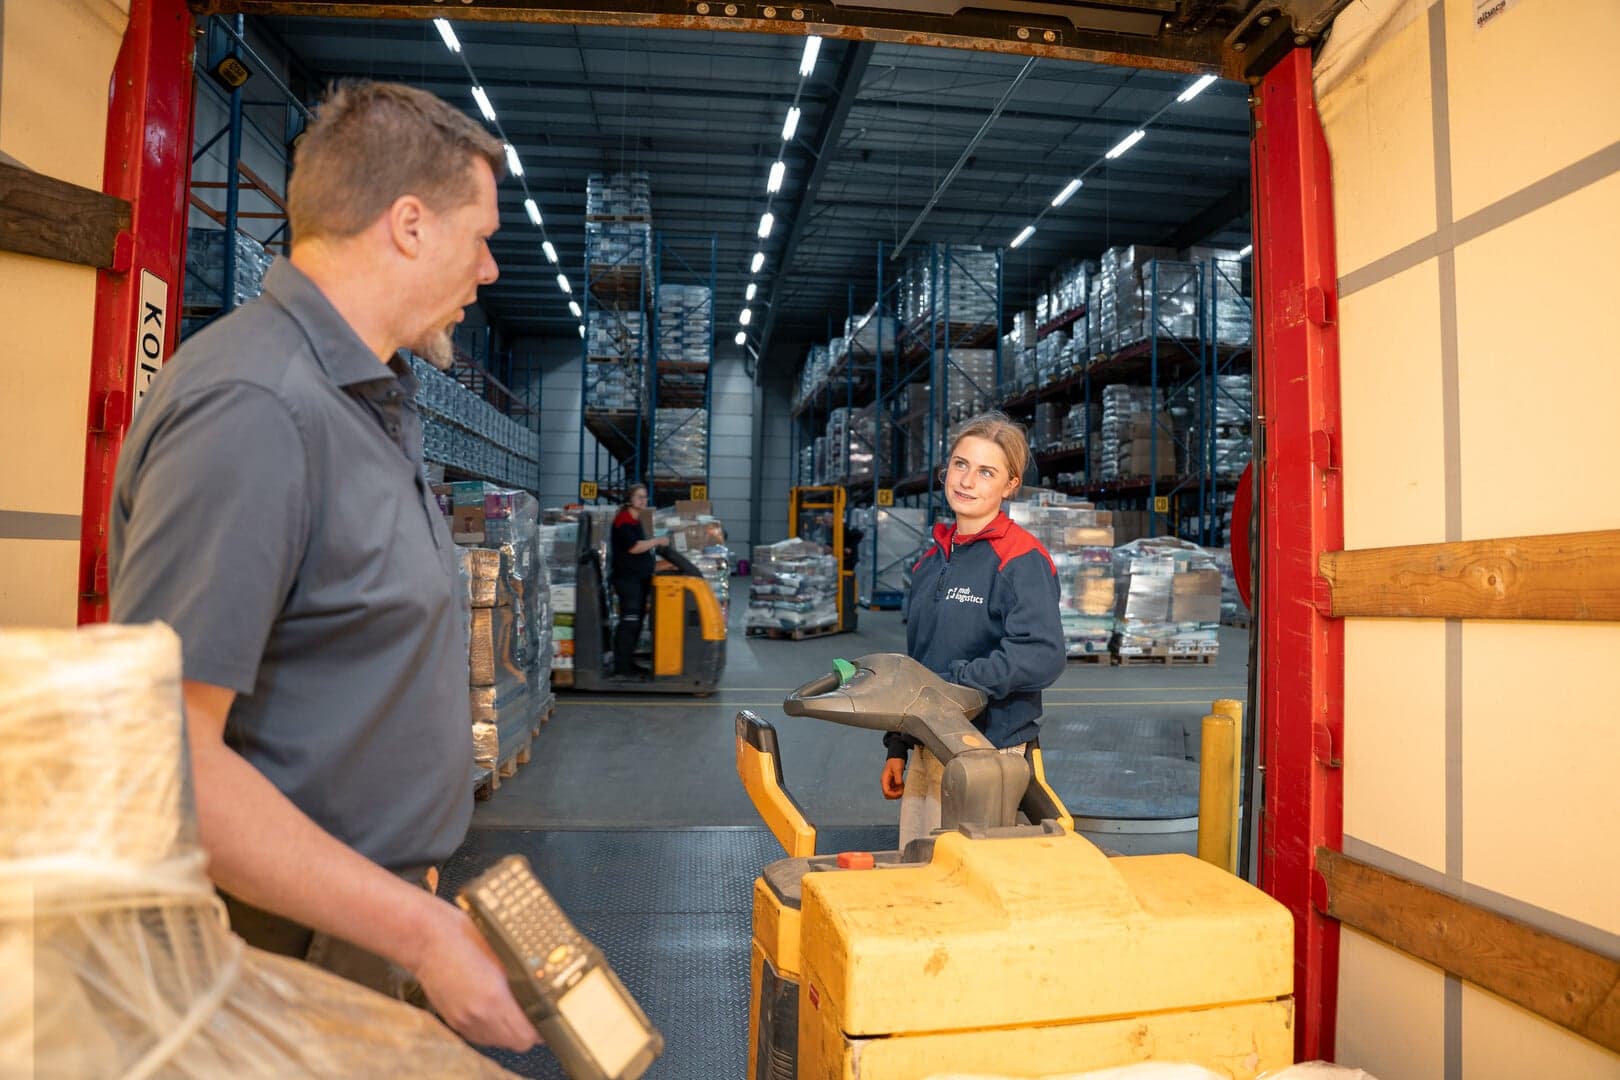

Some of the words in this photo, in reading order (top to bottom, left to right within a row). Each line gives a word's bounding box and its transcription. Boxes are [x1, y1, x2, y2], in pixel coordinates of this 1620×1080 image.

[583, 484, 595, 497] CH
[1156, 498, 1167, 510] CD
[955, 592, 984, 603] logistics
